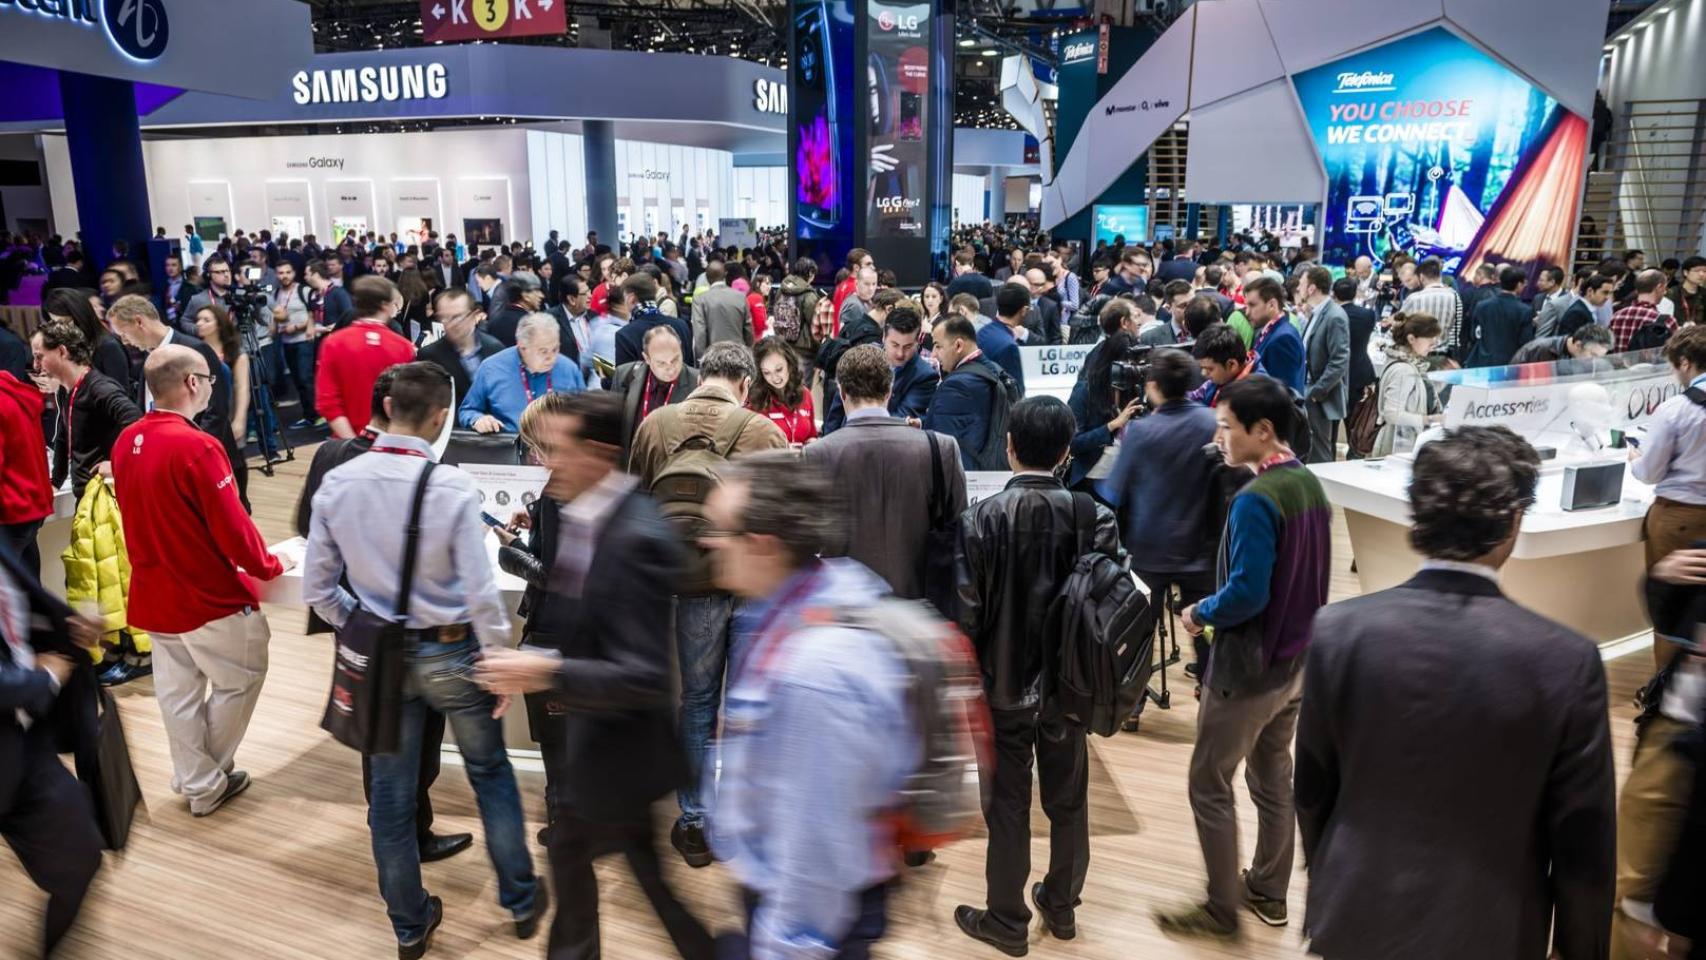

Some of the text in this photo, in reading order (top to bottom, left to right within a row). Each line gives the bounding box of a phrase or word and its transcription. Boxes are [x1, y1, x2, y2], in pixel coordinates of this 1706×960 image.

[452, 0, 533, 25] K 3 K
[897, 14, 918, 31] LG
[292, 62, 447, 105] SAMSUNG
[1329, 99, 1473, 122] YOU CHOOSE
[1327, 125, 1364, 145] WE
[308, 156, 345, 171] Galaxy
[876, 196, 890, 208] LG
[891, 195, 902, 208] G
[1038, 348, 1057, 361] LG
[1041, 363, 1060, 375] LG
[1463, 395, 1550, 420] Accessories
